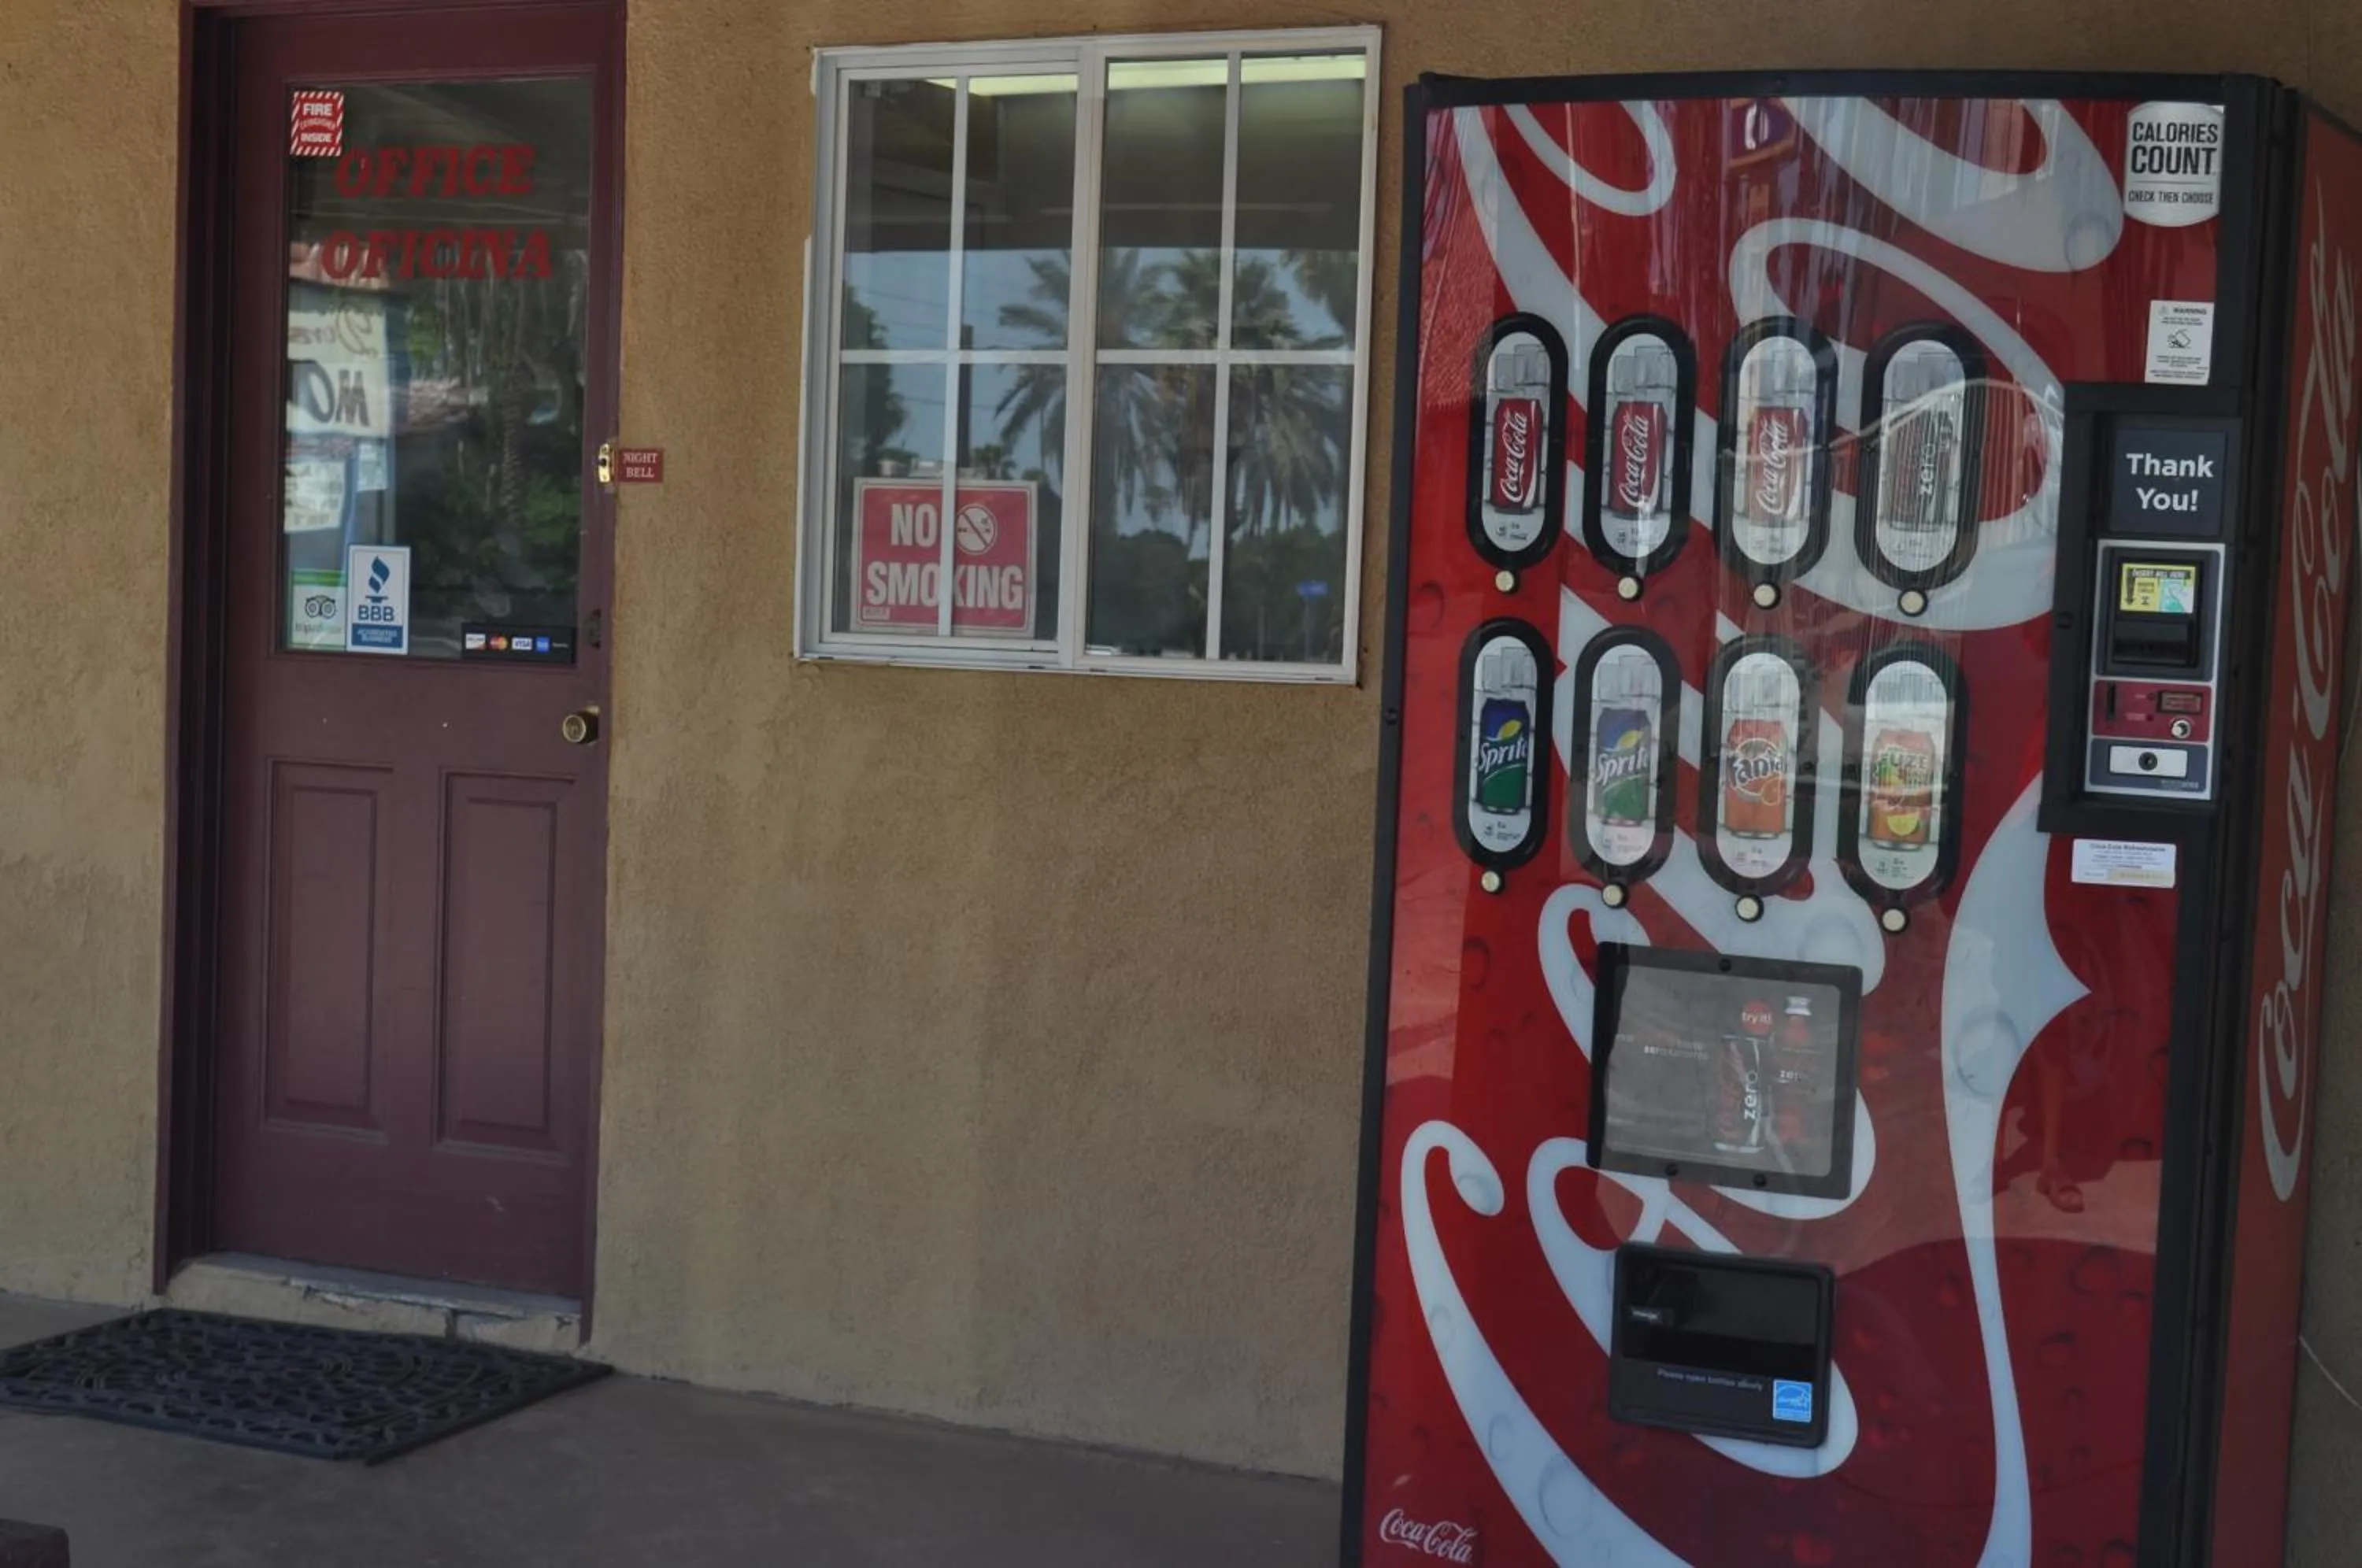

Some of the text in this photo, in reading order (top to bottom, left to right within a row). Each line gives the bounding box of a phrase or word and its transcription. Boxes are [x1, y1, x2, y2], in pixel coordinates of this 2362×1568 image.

[302, 102, 333, 116] FIRE
[2132, 121, 2218, 143] CALORIES
[336, 144, 536, 198] OFFICE
[2131, 145, 2217, 175] COUNT
[2128, 190, 2213, 204] CHECK THEN CHOOSE
[321, 228, 553, 280] OFICINA
[623, 453, 658, 464] NIGHT
[2126, 453, 2214, 478] Thank
[626, 467, 654, 478] BELL
[2136, 486, 2198, 512] You!
[891, 503, 937, 547] NO
[867, 561, 1023, 608] SMOKING
[358, 605, 394, 622] BBB
[1745, 1071, 1757, 1120] zero
[1379, 1508, 1477, 1563] Coca-Cola
